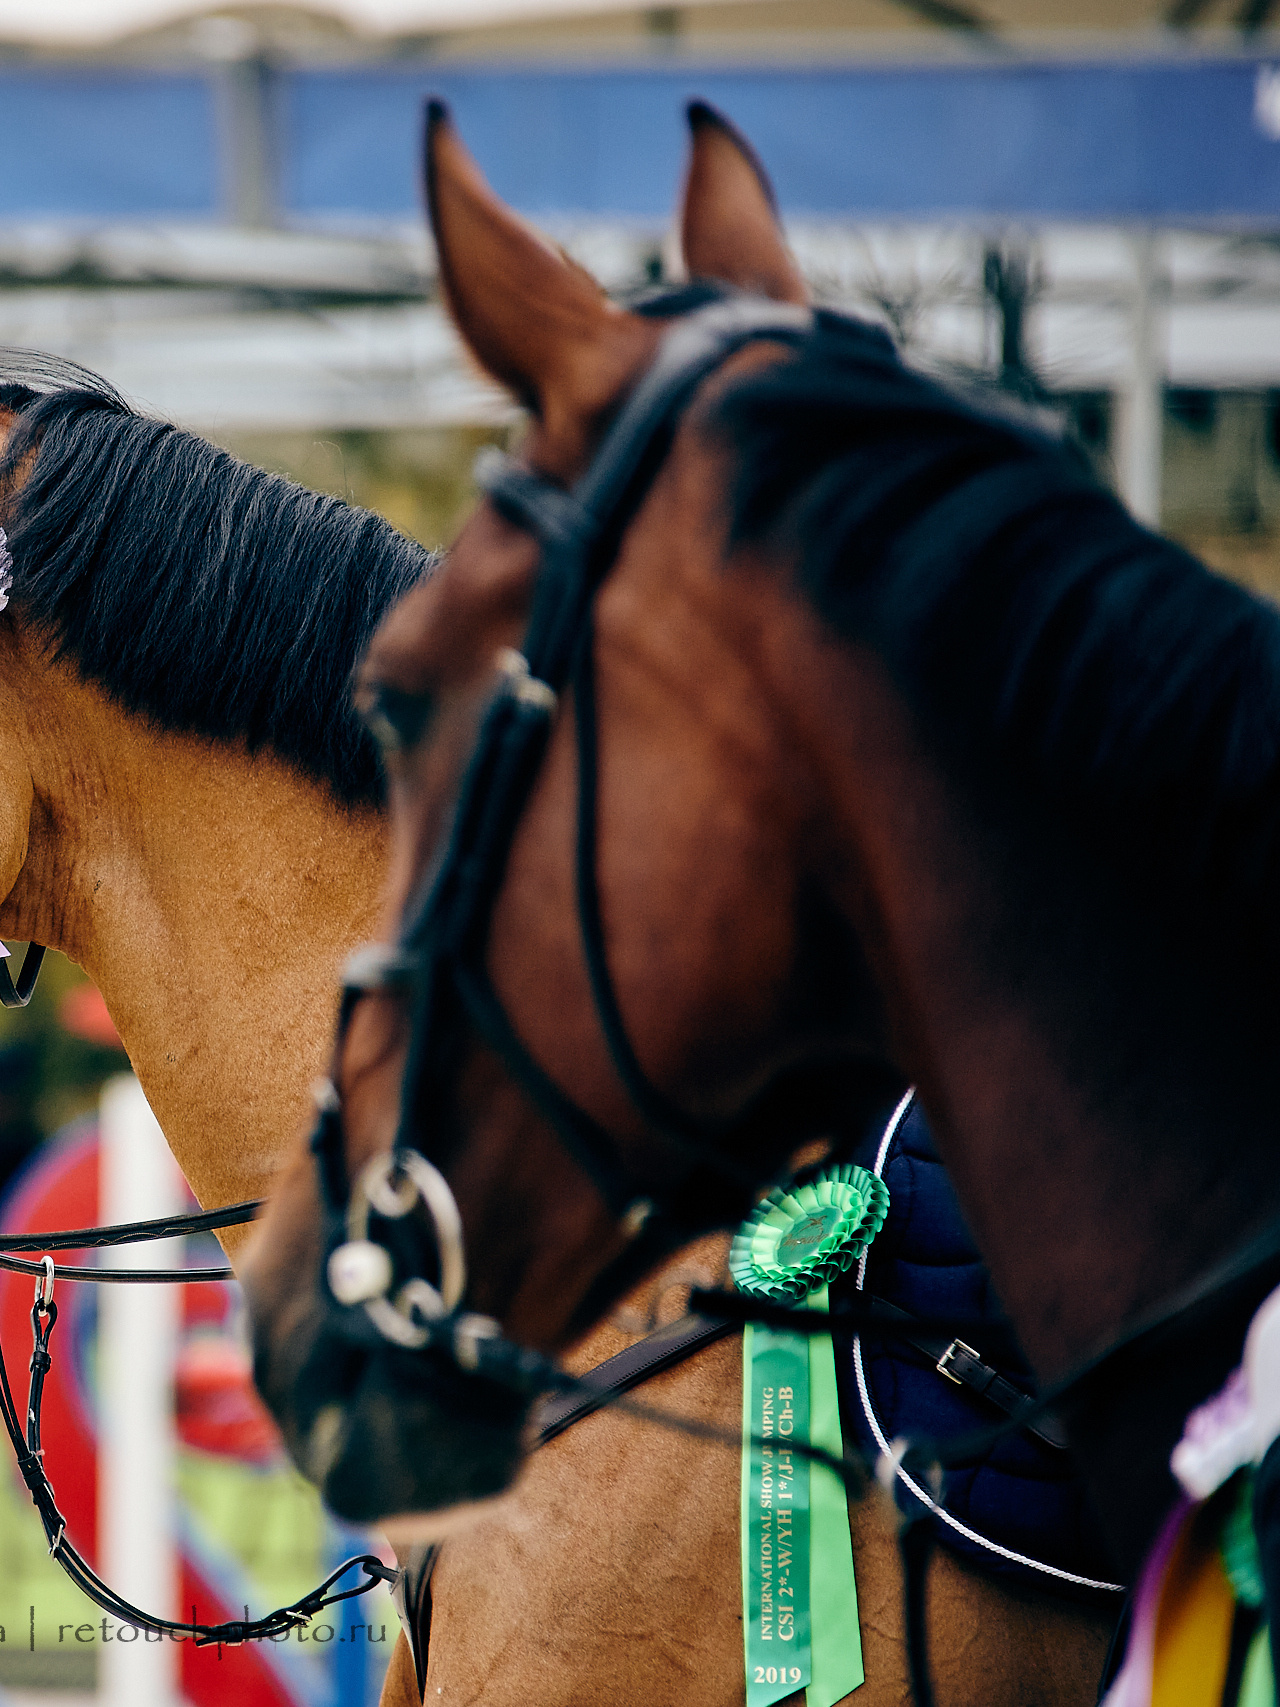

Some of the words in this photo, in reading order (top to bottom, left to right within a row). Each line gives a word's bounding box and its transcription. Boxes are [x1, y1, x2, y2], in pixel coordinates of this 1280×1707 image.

[762, 1387, 774, 1458] JMPING
[760, 1461, 774, 1509] SHOW
[760, 1511, 773, 1641] INTERNATIONAL
[778, 1605, 794, 1642] CSI
[753, 1665, 802, 1684] 2019
